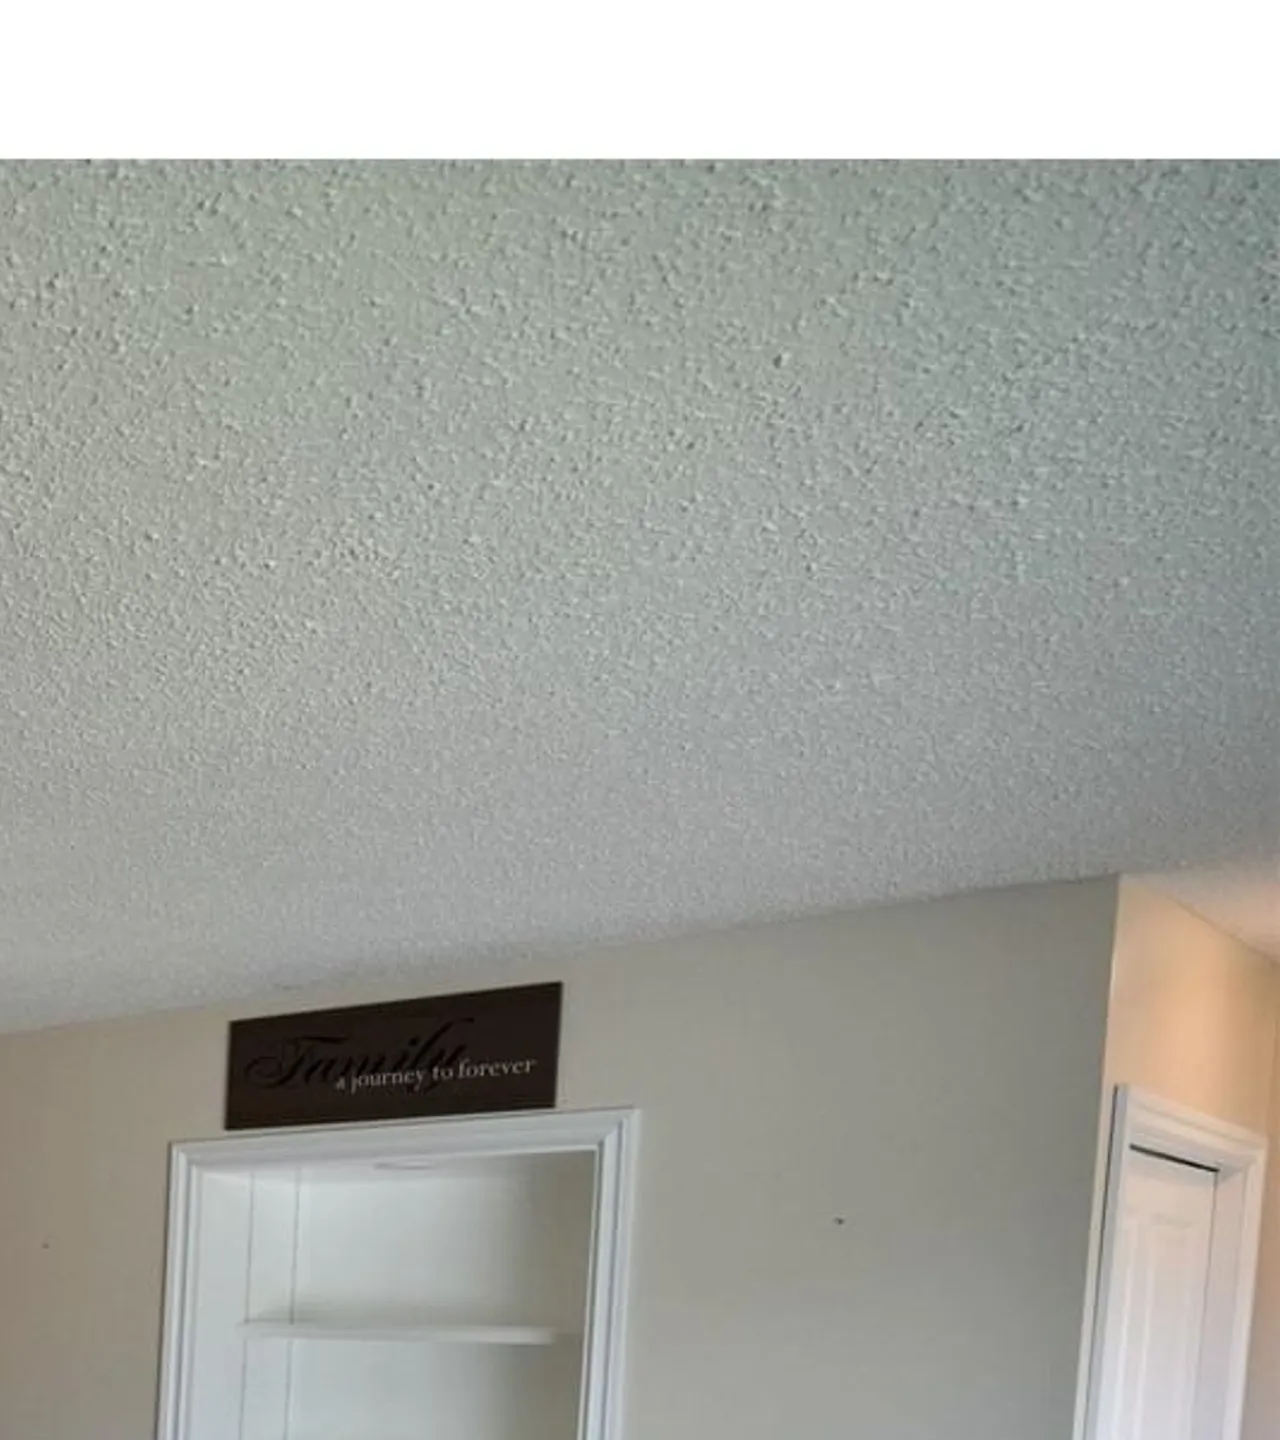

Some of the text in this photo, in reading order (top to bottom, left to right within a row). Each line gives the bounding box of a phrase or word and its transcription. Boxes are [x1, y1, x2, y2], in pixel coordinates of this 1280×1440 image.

[243, 1017, 475, 1095] Family
[334, 1056, 537, 1095] a journey to forever
